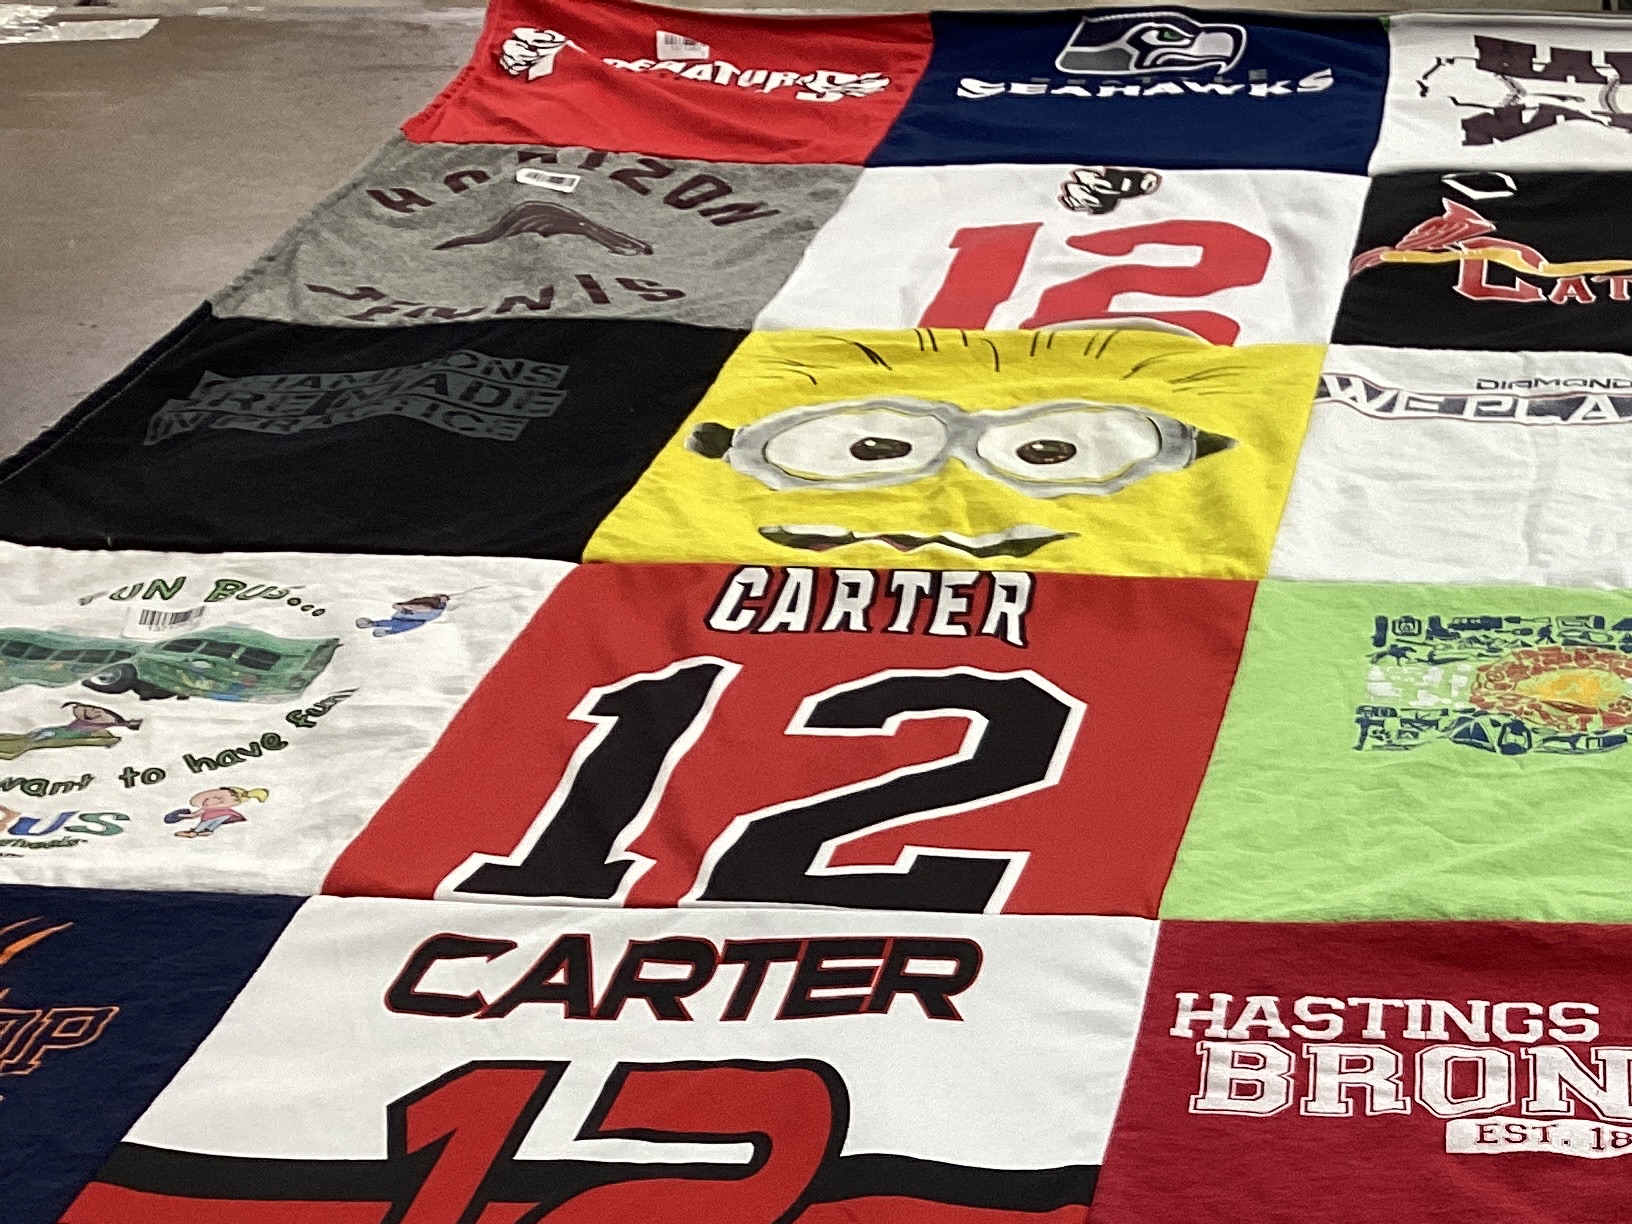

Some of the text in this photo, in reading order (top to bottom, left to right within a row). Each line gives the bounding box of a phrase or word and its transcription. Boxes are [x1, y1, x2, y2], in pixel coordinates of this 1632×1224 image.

[956, 68, 1334, 98] SEAHAWKS
[918, 219, 1272, 346] 12
[704, 566, 1037, 648] CARTER
[118, 765, 167, 789] to
[182, 731, 290, 774] have
[433, 655, 1088, 915] 12
[384, 932, 984, 1021] CARTER
[1169, 991, 1600, 1043] HASTINGS
[1473, 1122, 1571, 1148] EST.
